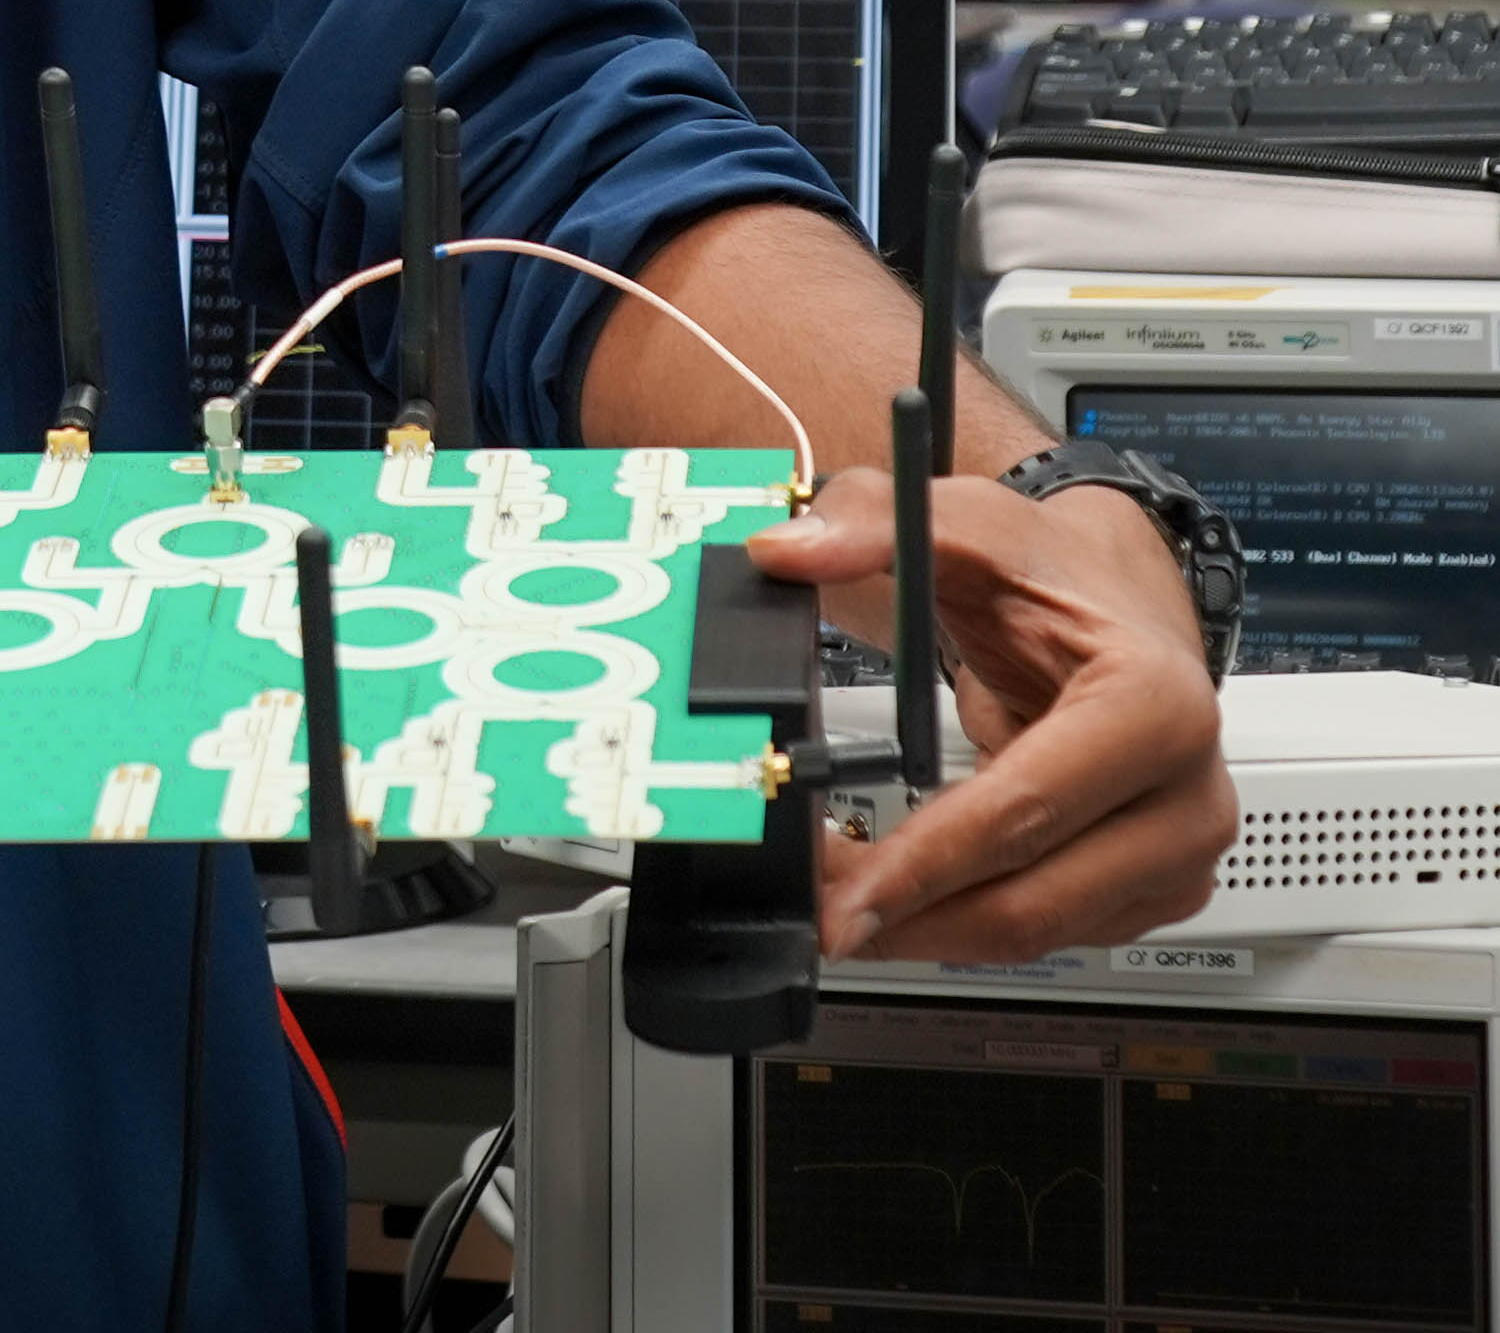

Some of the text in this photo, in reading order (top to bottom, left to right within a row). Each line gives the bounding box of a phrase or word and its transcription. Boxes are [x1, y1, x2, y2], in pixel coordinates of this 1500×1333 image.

[1061, 328, 1106, 343] Agilent
[1271, 550, 1295, 564] 533
[1308, 550, 1342, 564] (Dual
[1347, 551, 1398, 565] Channel
[1403, 552, 1433, 565] Mode
[1438, 553, 1496, 566] Enabled)
[1155, 950, 1237, 969] QiCF1396
